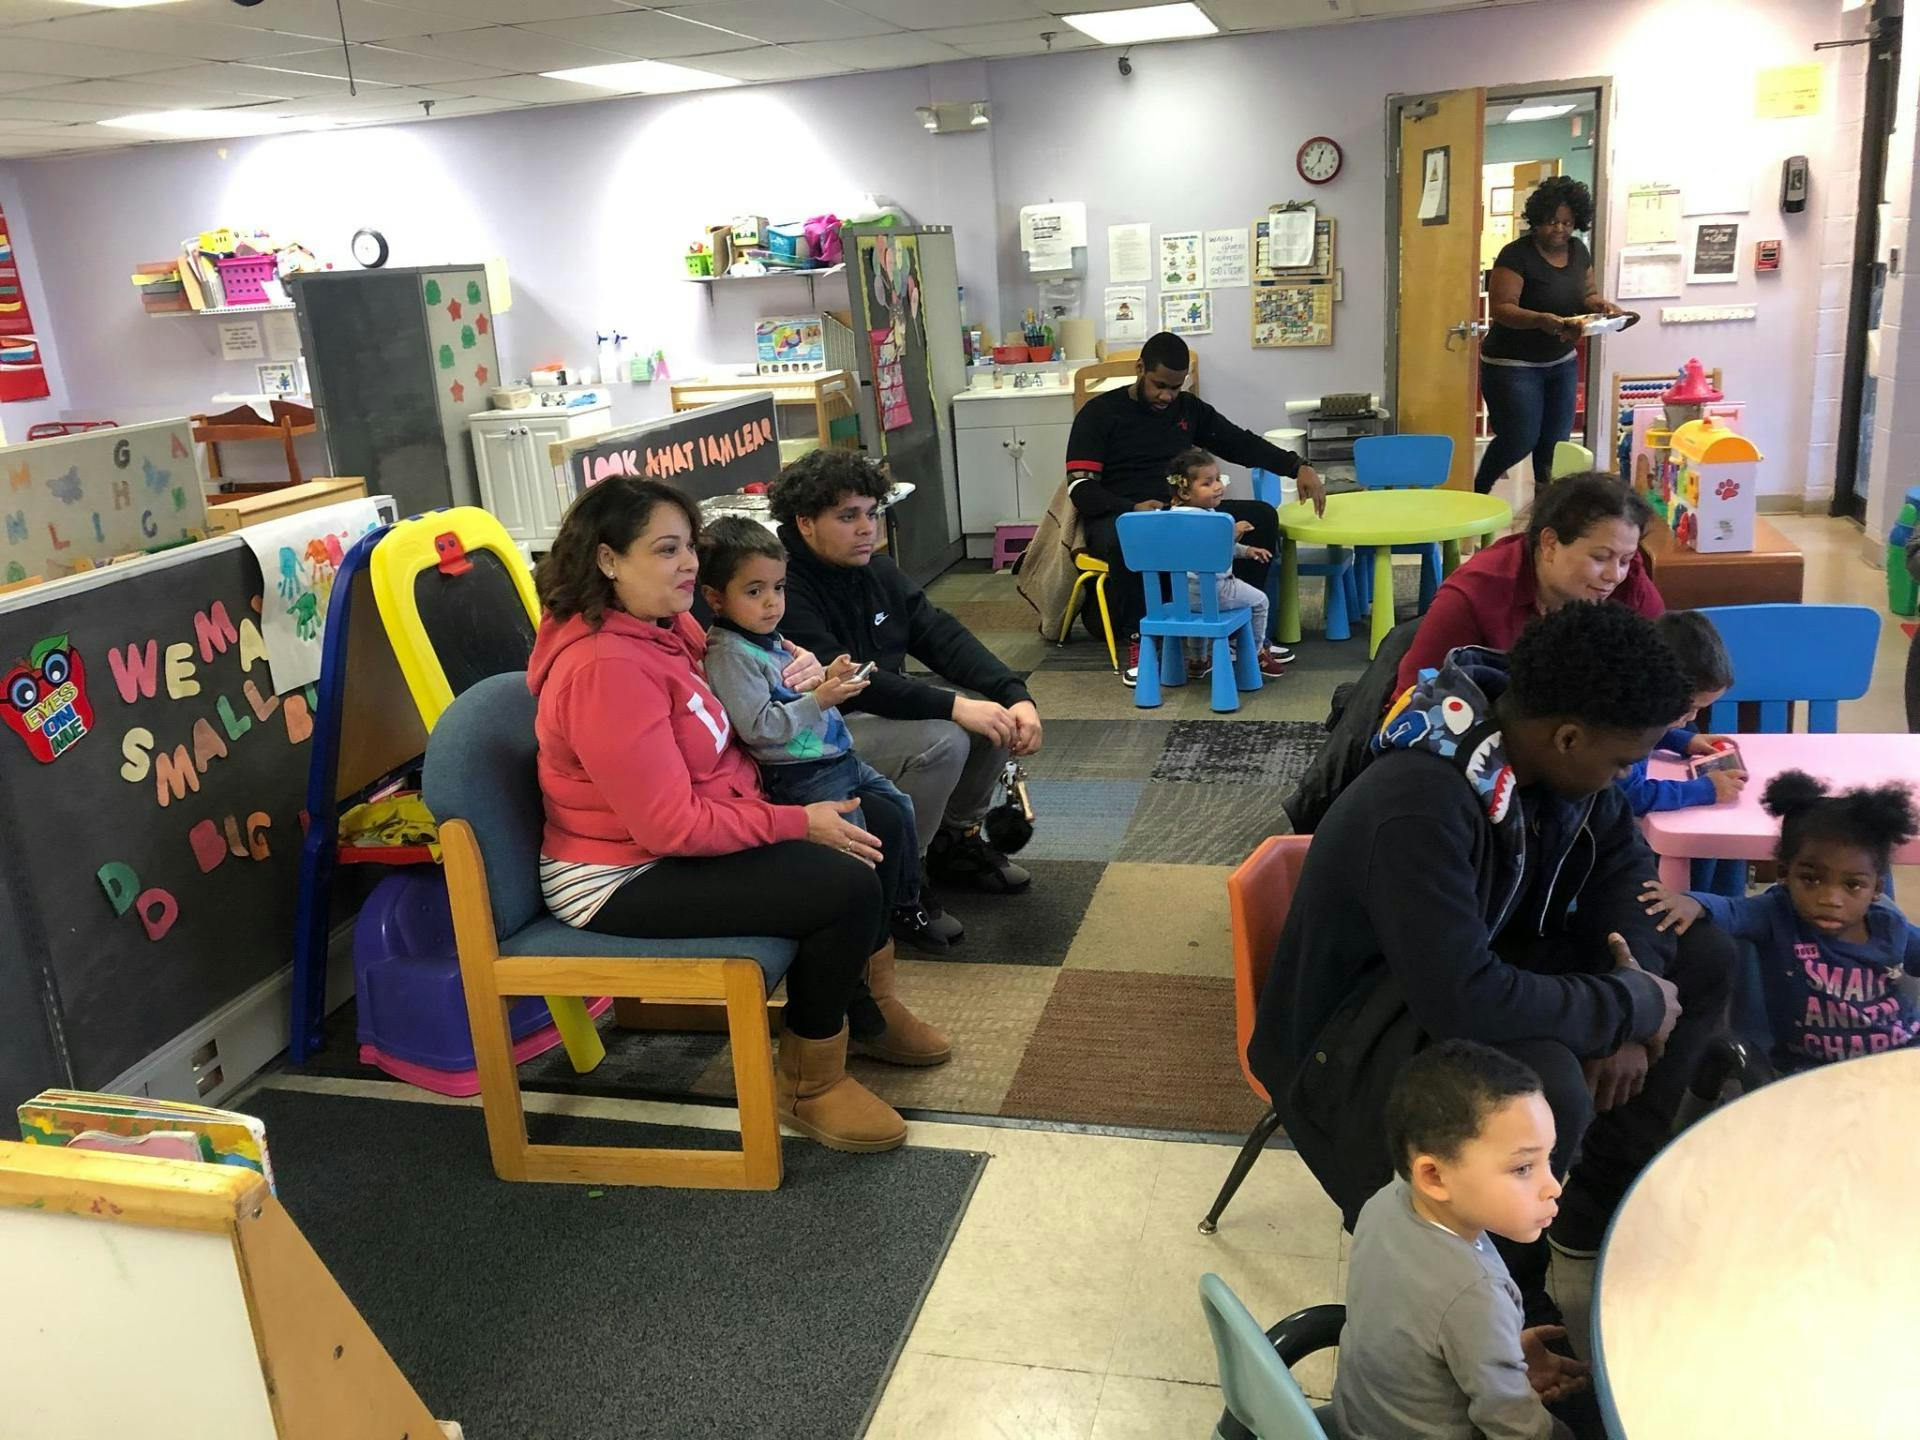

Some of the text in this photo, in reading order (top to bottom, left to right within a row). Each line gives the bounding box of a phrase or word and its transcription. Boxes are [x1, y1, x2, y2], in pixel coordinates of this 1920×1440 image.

[583, 450, 640, 488] LOOK
[108, 640, 200, 703] WE
[23, 681, 78, 732] EYES
[42, 701, 77, 738] ON
[49, 715, 88, 758] ME
[121, 680, 280, 807] SMALL
[97, 861, 179, 941] DO
[189, 811, 272, 873] BIG
